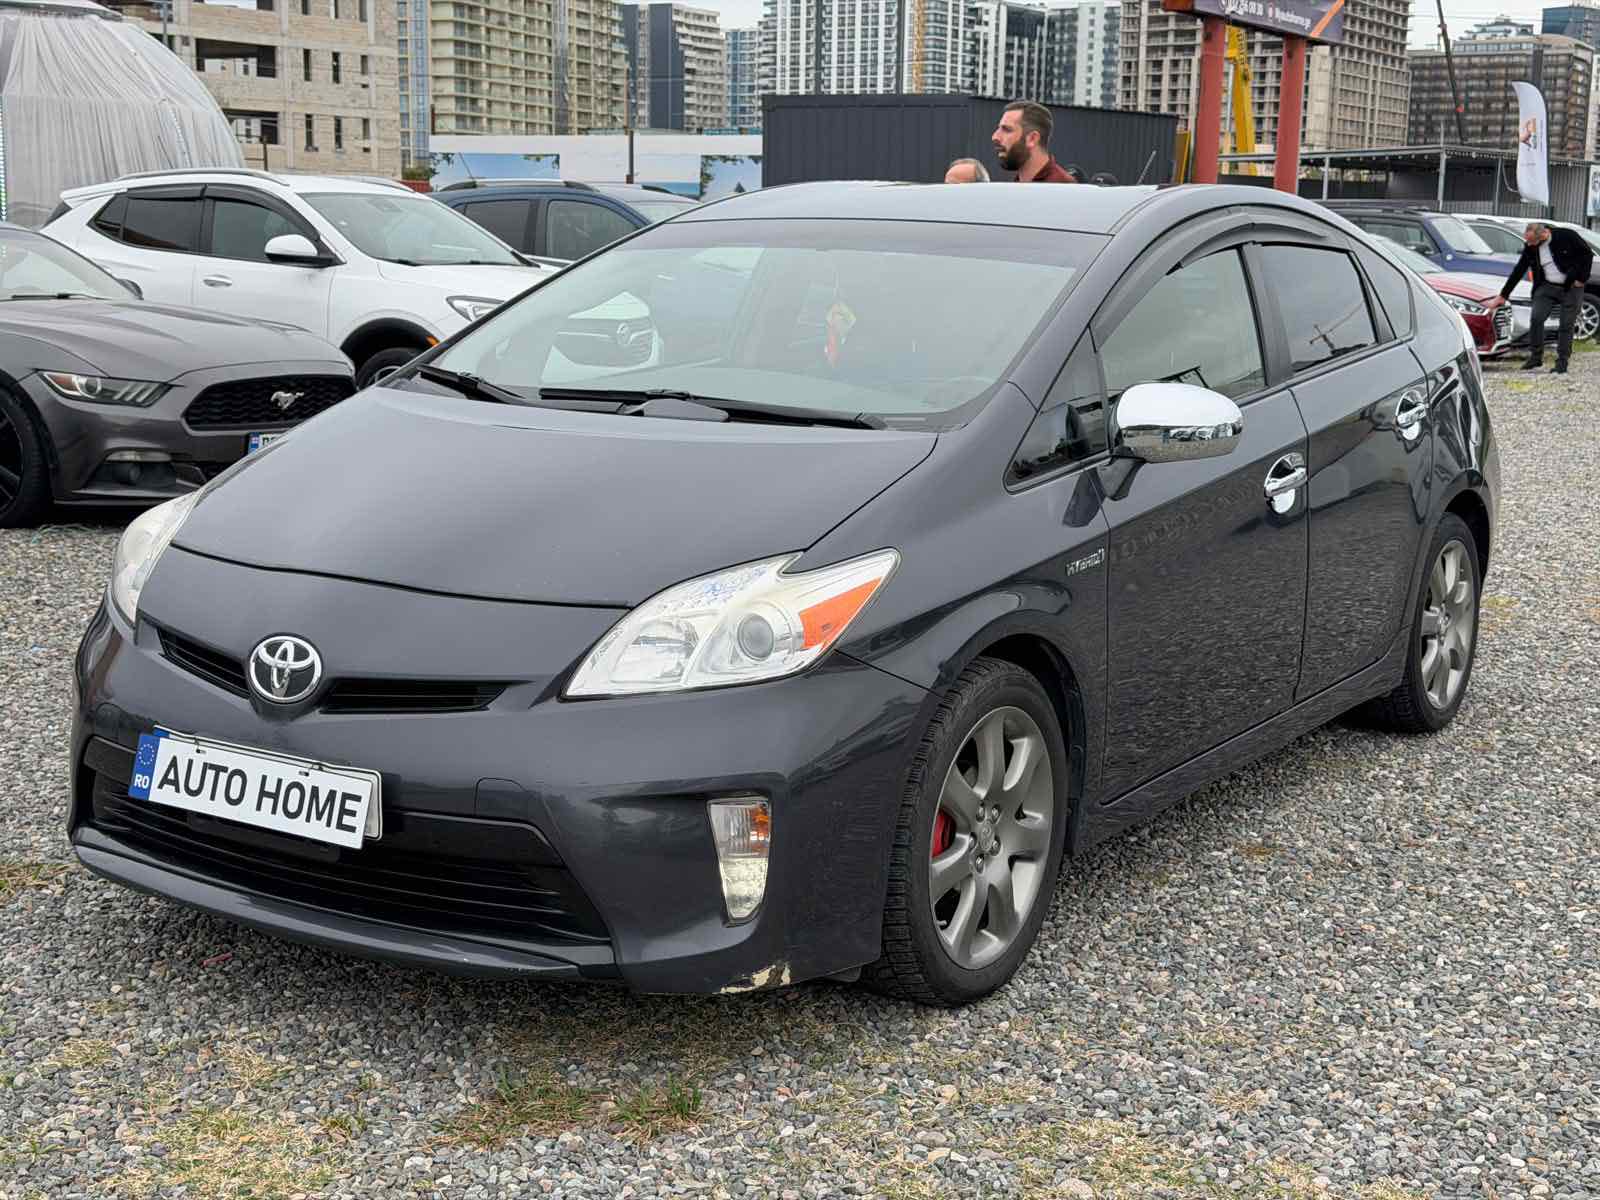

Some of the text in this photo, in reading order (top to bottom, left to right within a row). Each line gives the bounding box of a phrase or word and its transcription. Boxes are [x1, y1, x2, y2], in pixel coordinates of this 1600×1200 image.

[133, 772, 150, 790] RO
[157, 755, 362, 834] AUTO HOME
